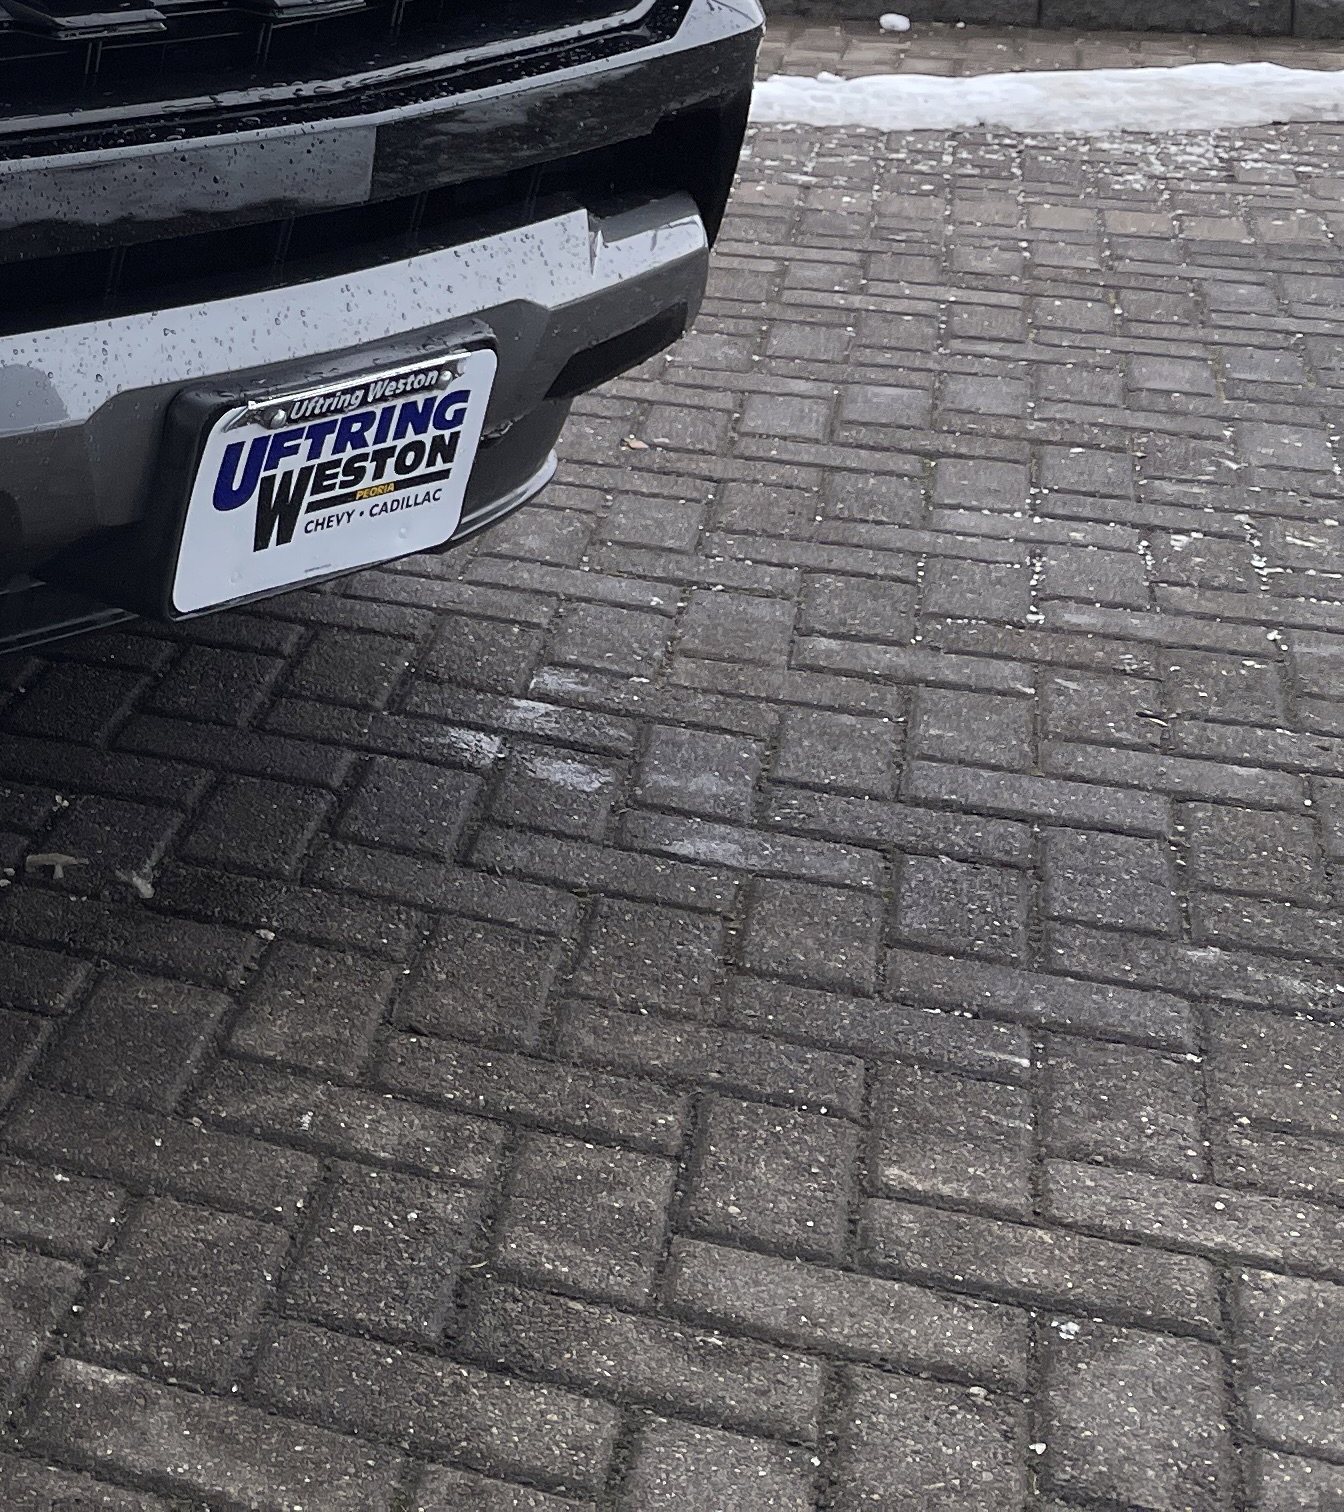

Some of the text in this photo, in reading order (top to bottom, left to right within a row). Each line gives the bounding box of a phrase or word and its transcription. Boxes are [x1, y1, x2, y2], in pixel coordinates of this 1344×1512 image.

[290, 370, 439, 420] Uftring Weston
[212, 390, 471, 512] UFTRING
[253, 431, 461, 553] WESTON
[304, 488, 443, 534] CHEVY CADILLAC
[355, 482, 395, 501] PEORIA
